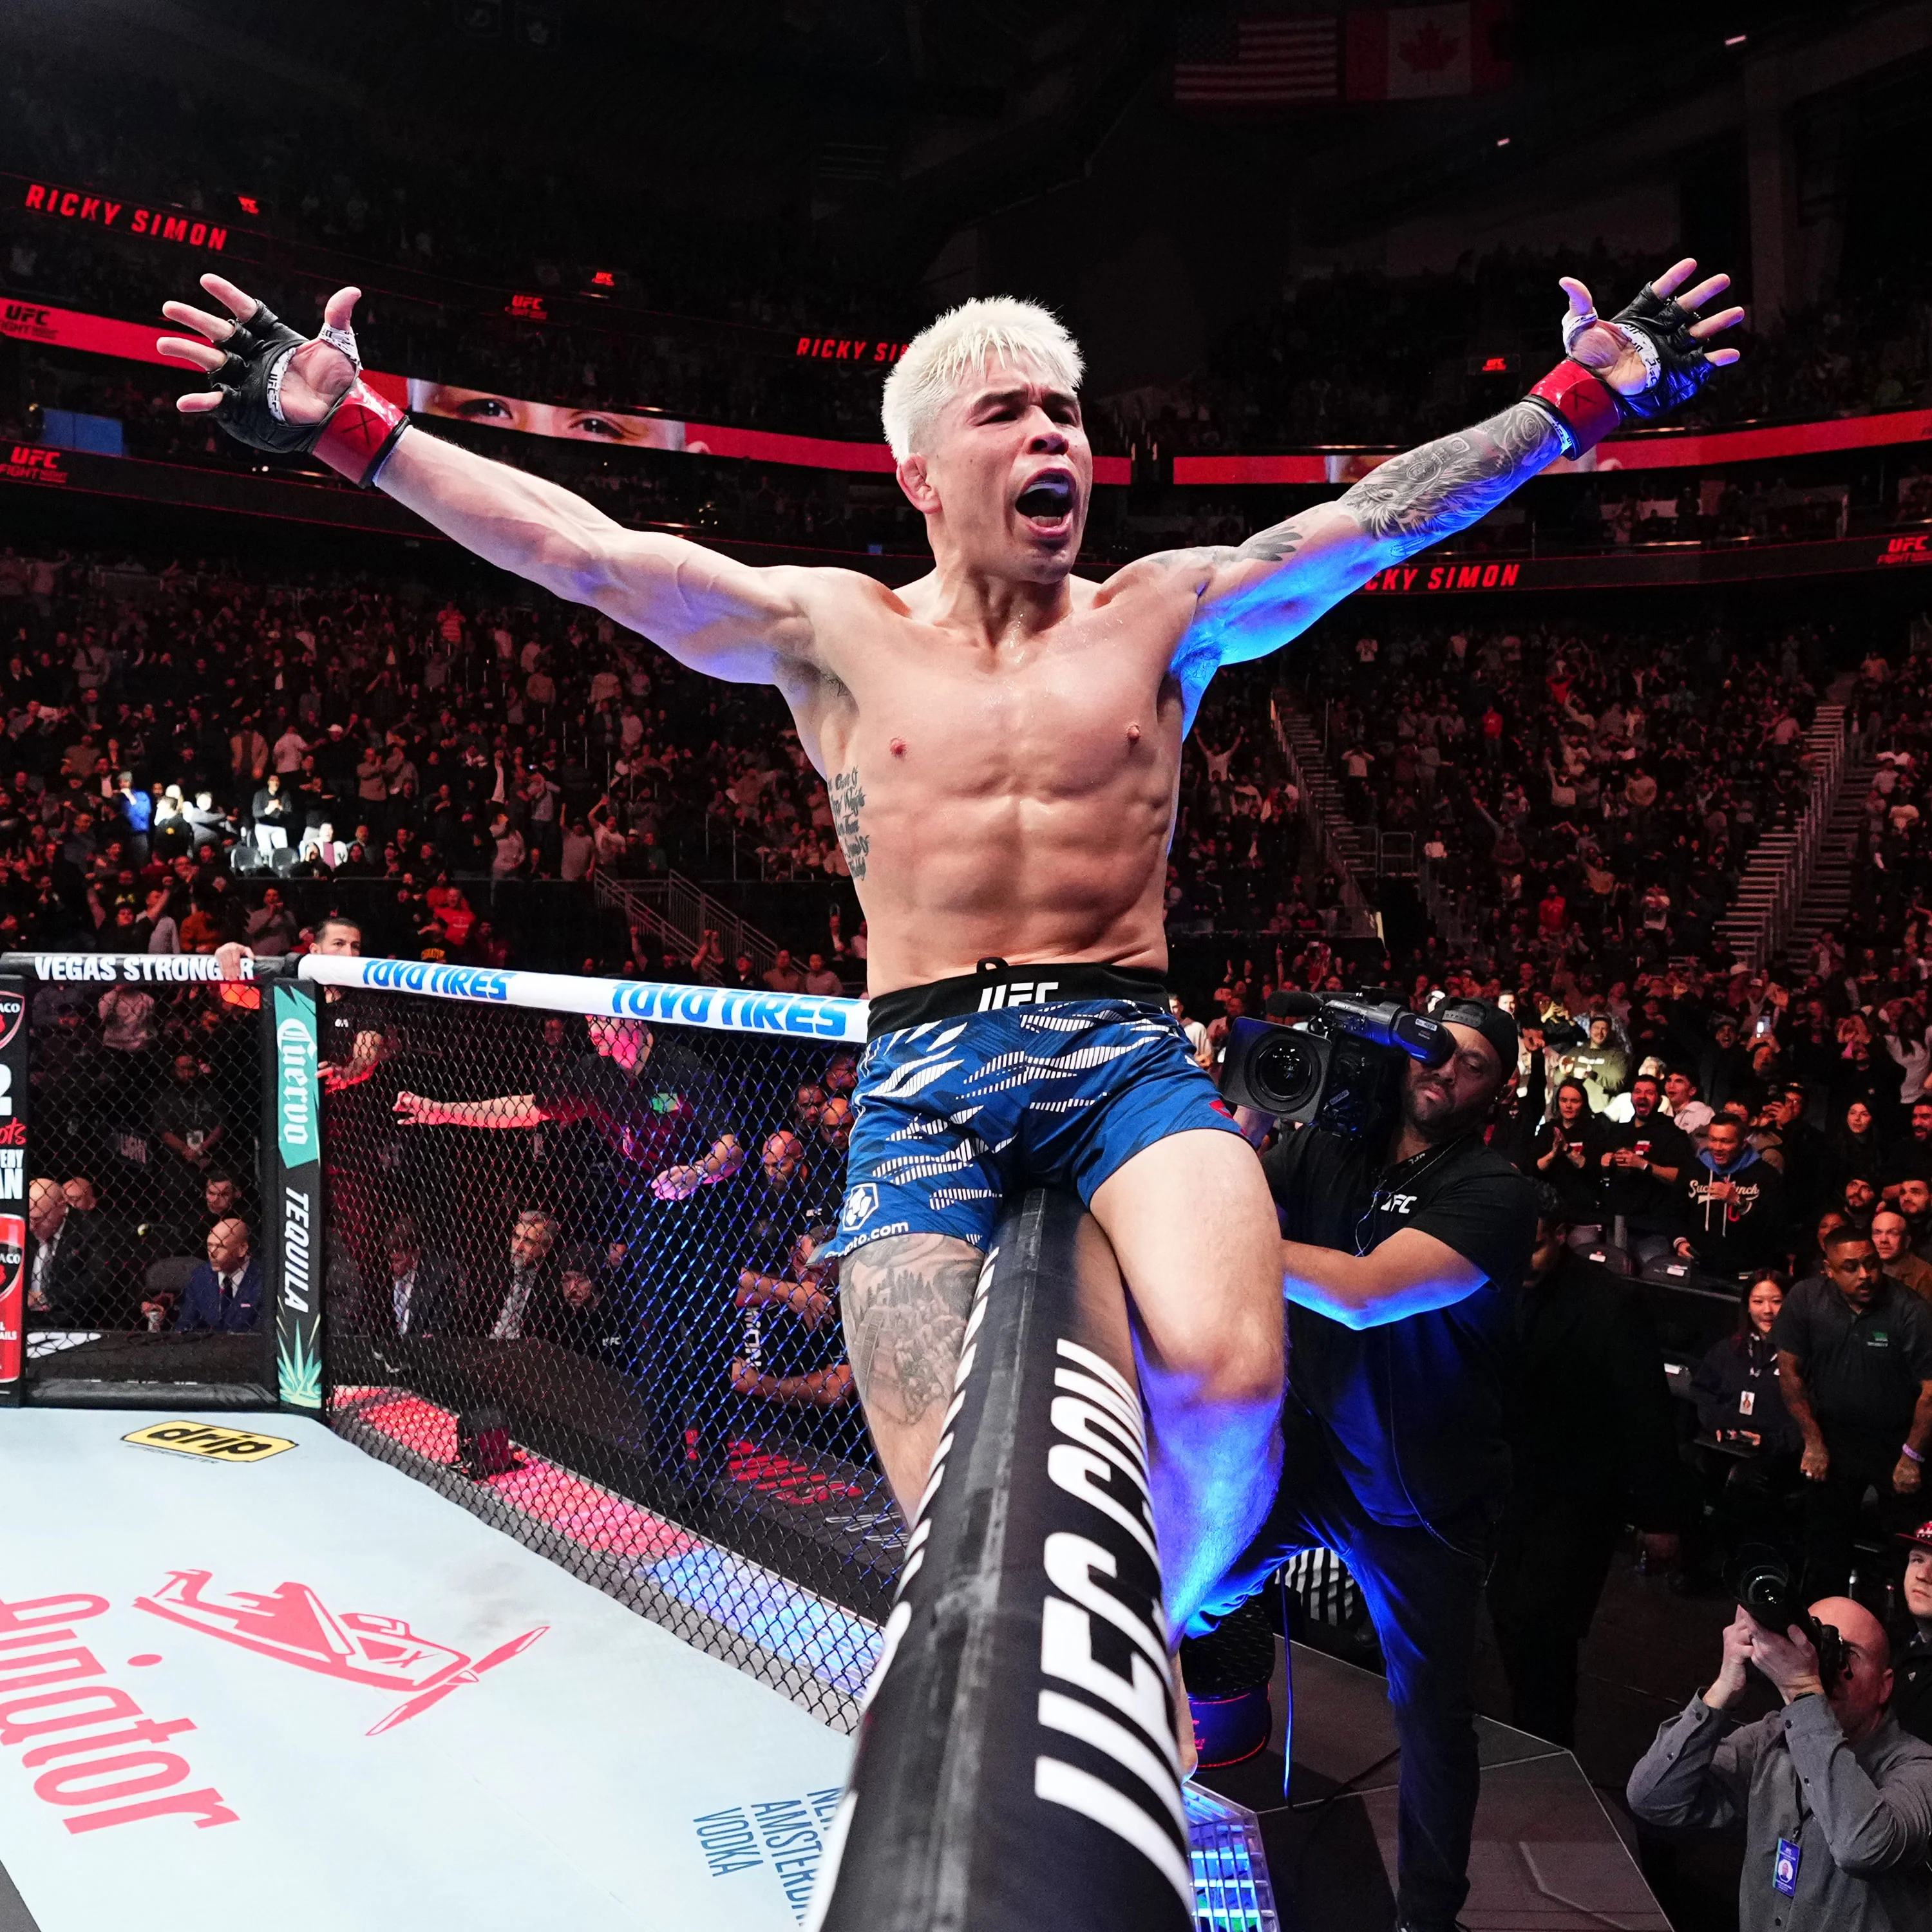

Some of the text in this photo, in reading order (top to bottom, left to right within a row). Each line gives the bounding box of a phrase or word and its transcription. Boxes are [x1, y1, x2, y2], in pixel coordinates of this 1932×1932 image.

[25, 184, 227, 251] RICKY SIMON
[5, 305, 50, 326] UFC
[512, 295, 543, 310] UFC
[796, 337, 867, 360] RICKY
[10, 446, 61, 469] UFC
[1888, 535, 1929, 553] UFC
[1363, 564, 1520, 591] CKY SIMON
[35, 956, 255, 981] VEGAS STRONGR
[363, 960, 519, 1001] TOYO TIRES
[612, 982, 860, 1037] TOYO TIRES
[276, 1018, 317, 1145] Cuervo
[1688, 1179, 1710, 1198] Suc
[285, 1187, 309, 1314] TEQUILA
[146, 1428, 272, 1454] drip
[692, 1806, 764, 1877] VODKA
[750, 1799, 823, 1927] AMSTERD
